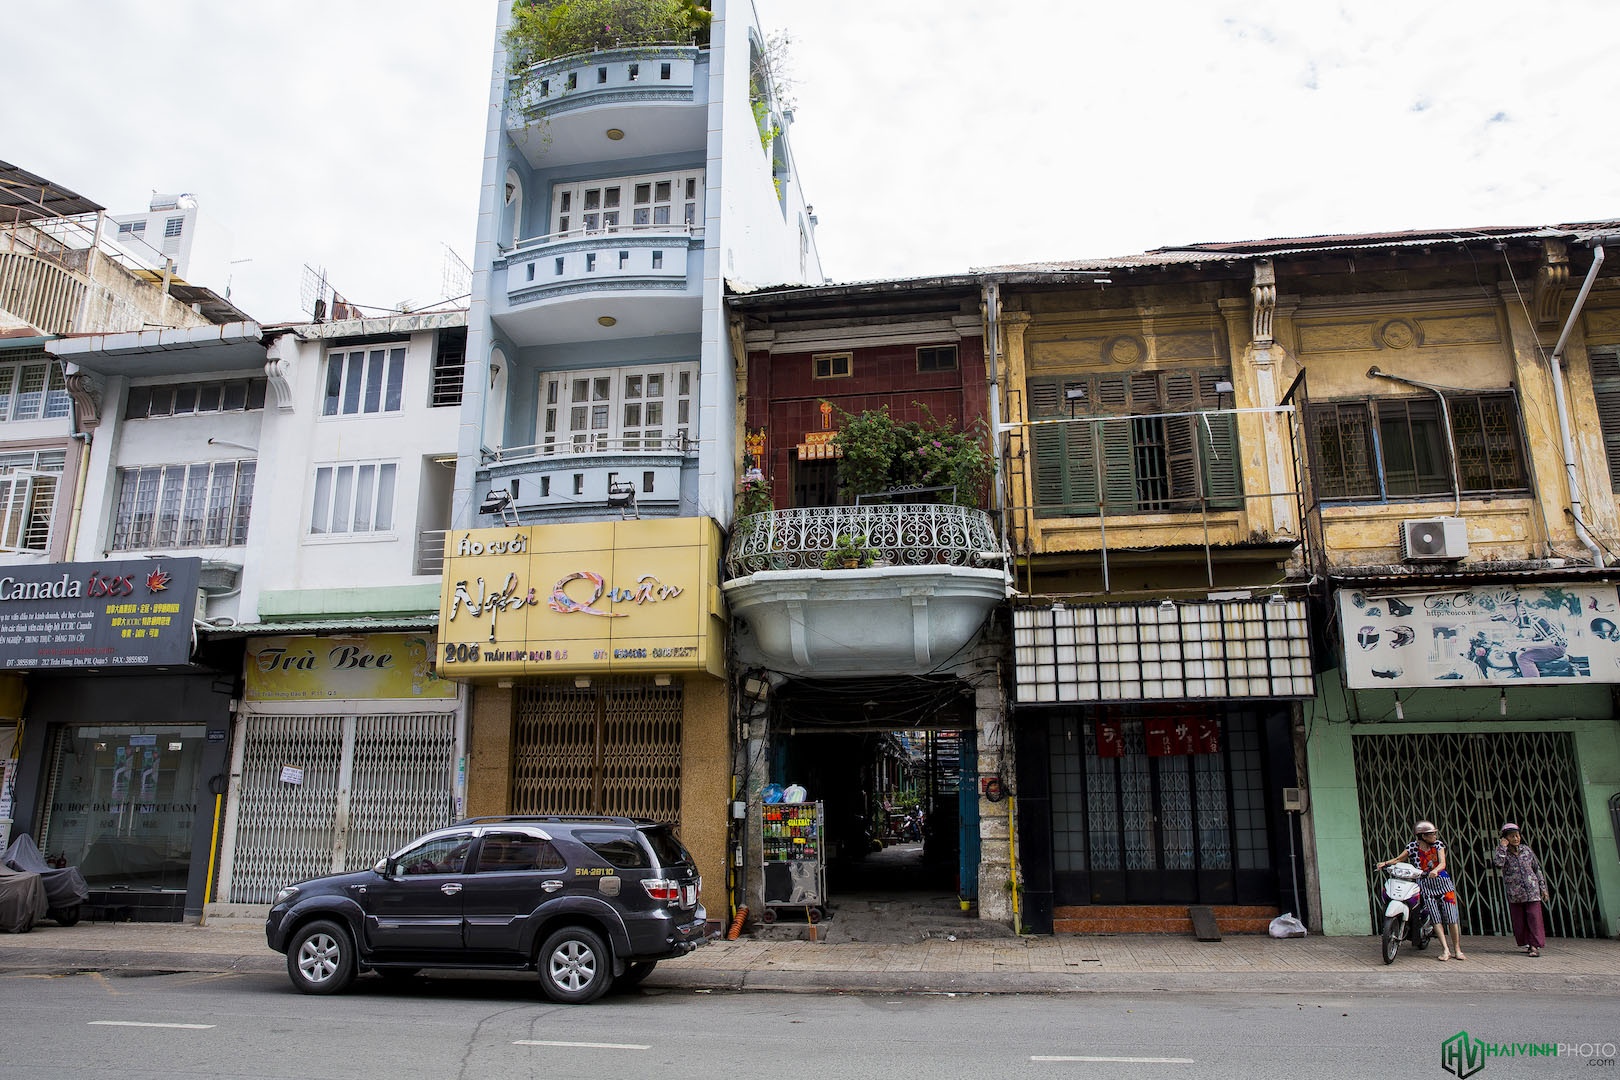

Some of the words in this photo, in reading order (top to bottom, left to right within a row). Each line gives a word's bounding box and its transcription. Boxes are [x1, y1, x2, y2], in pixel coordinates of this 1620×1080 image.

[457, 533, 483, 556] Áo
[486, 533, 528, 554] cưới
[0, 573, 81, 600] Canada
[87, 570, 135, 598] ises
[450, 572, 539, 643] Nghi
[549, 571, 684, 618] Quân
[256, 647, 320, 673] Trà
[328, 645, 396, 671] Bee
[445, 642, 480, 663] 208
